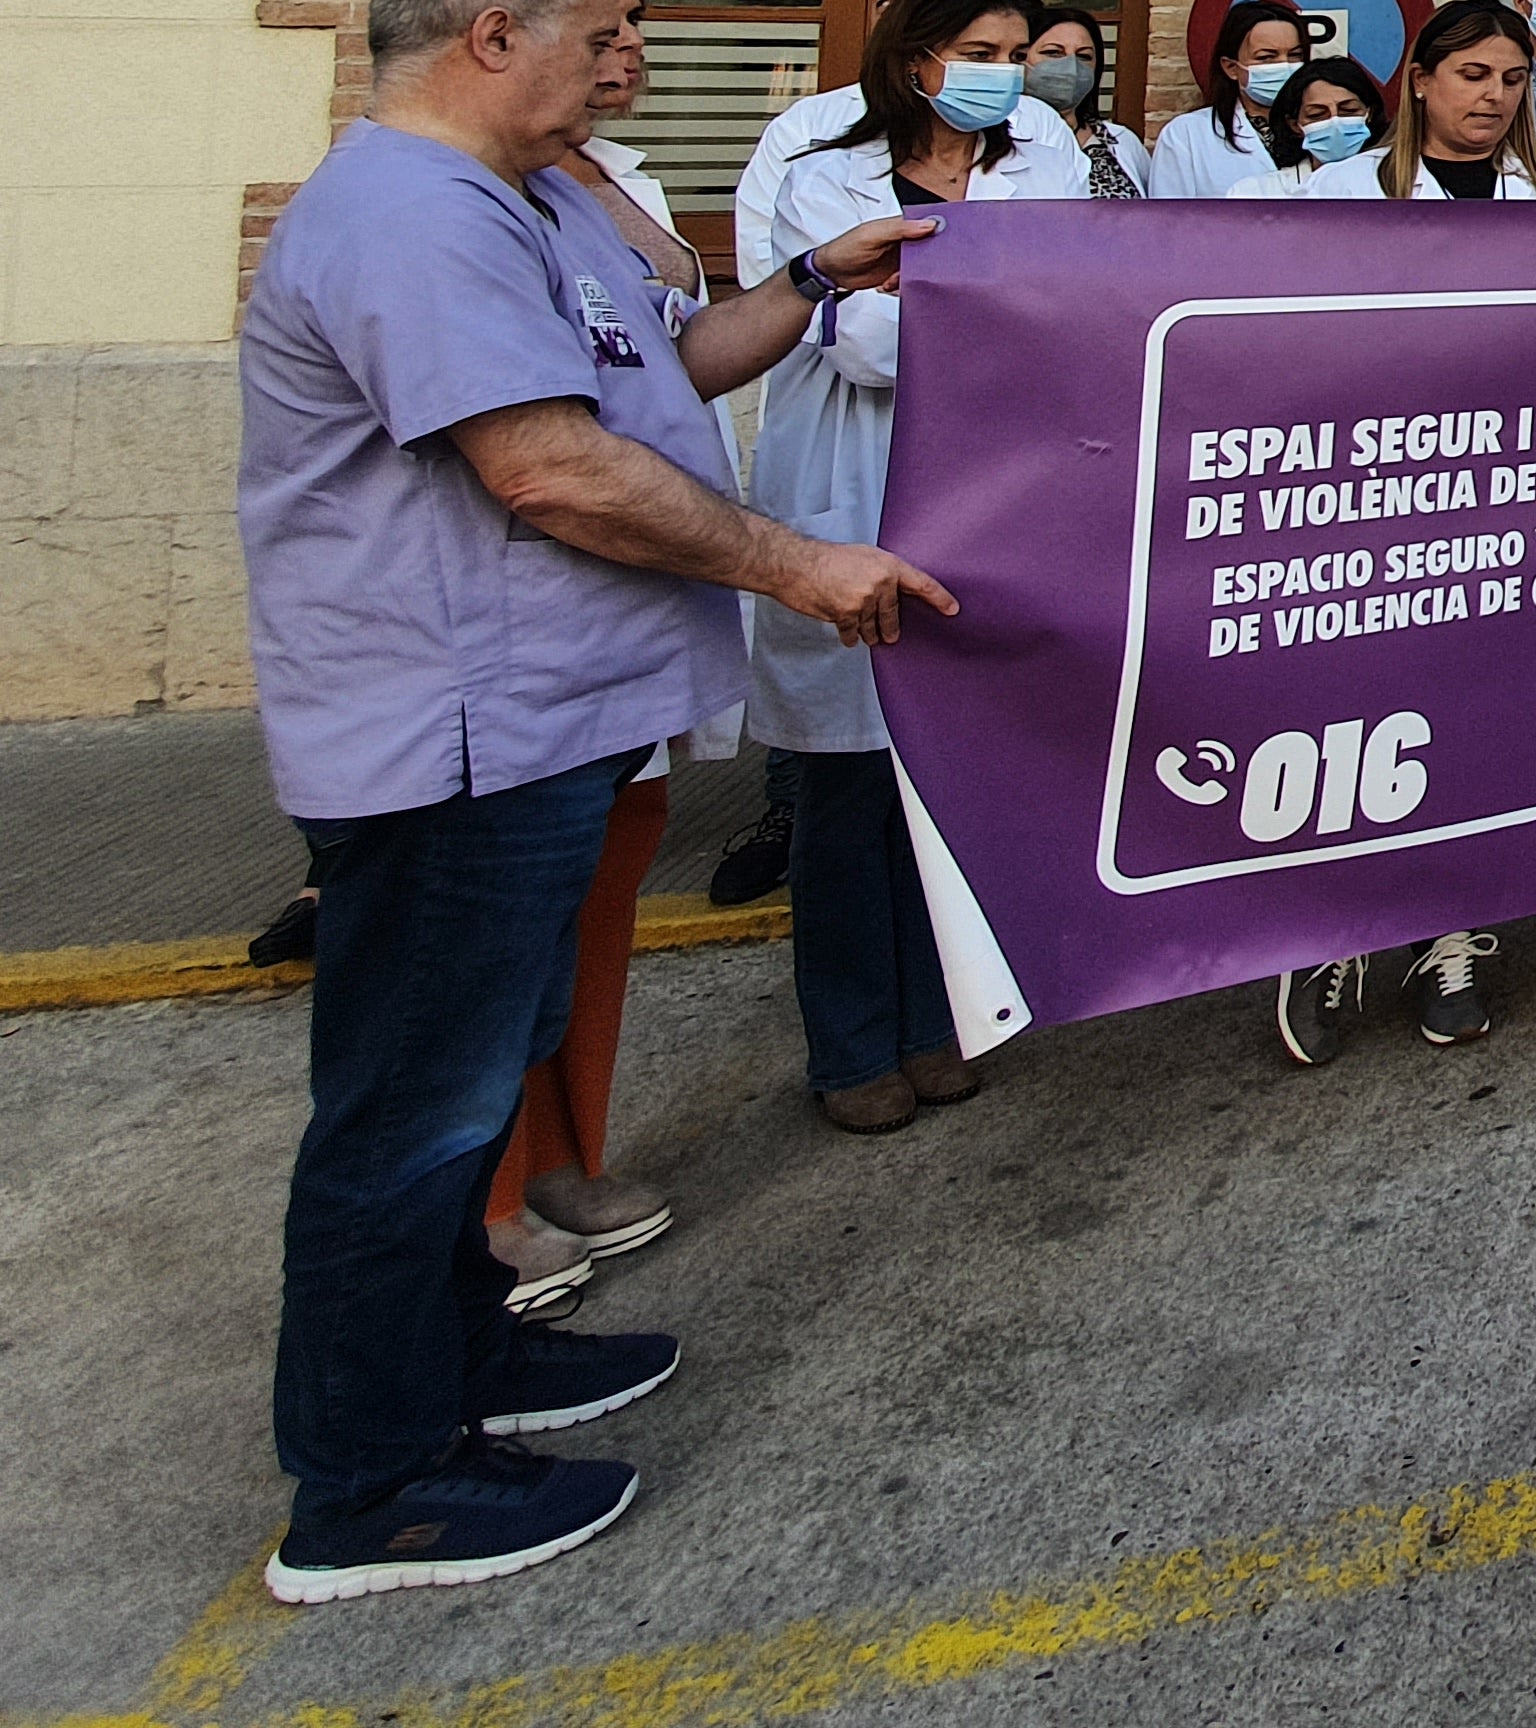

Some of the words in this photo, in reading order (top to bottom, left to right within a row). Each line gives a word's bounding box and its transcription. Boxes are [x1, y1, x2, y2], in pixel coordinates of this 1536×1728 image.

[1188, 422, 1335, 481] ESPAI
[1350, 409, 1503, 467] SEGUR
[1517, 406, 1533, 451] I
[1185, 492, 1245, 540] DE
[1258, 467, 1478, 531] VIOLÈNCIA
[1489, 463, 1536, 506] DE
[1212, 549, 1374, 606] ESPACIO
[1384, 530, 1525, 583] SEGURO
[1208, 613, 1261, 658] DE
[1273, 584, 1469, 648] VIOLENCIA
[1479, 576, 1523, 616] DE
[1238, 709, 1433, 842] 016
